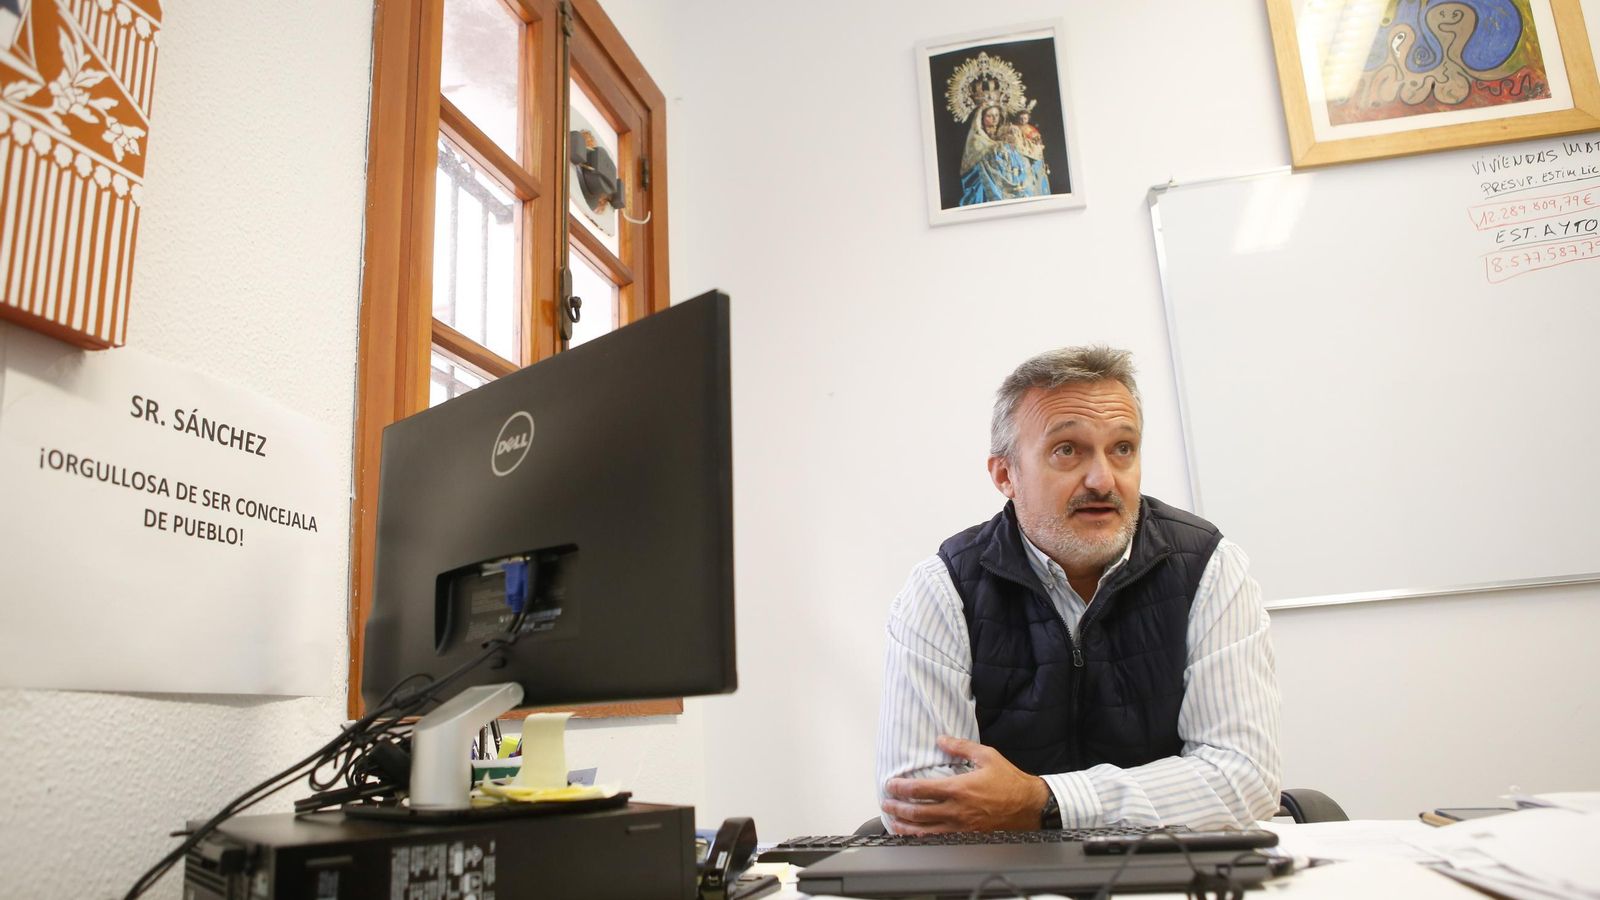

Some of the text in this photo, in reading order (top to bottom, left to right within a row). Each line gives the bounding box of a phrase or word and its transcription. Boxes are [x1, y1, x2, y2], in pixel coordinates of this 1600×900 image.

[1472, 151, 1558, 175] VIVIENDAS
[1496, 219, 1598, 244] EST. AYTO
[130, 395, 267, 457] SR. SÁNCHEZ
[496, 432, 528, 456] DELL
[39, 447, 318, 533] ¡ORGULLOSA DE SER CONCEJALA
[143, 508, 244, 547] DE PUEBLO!
